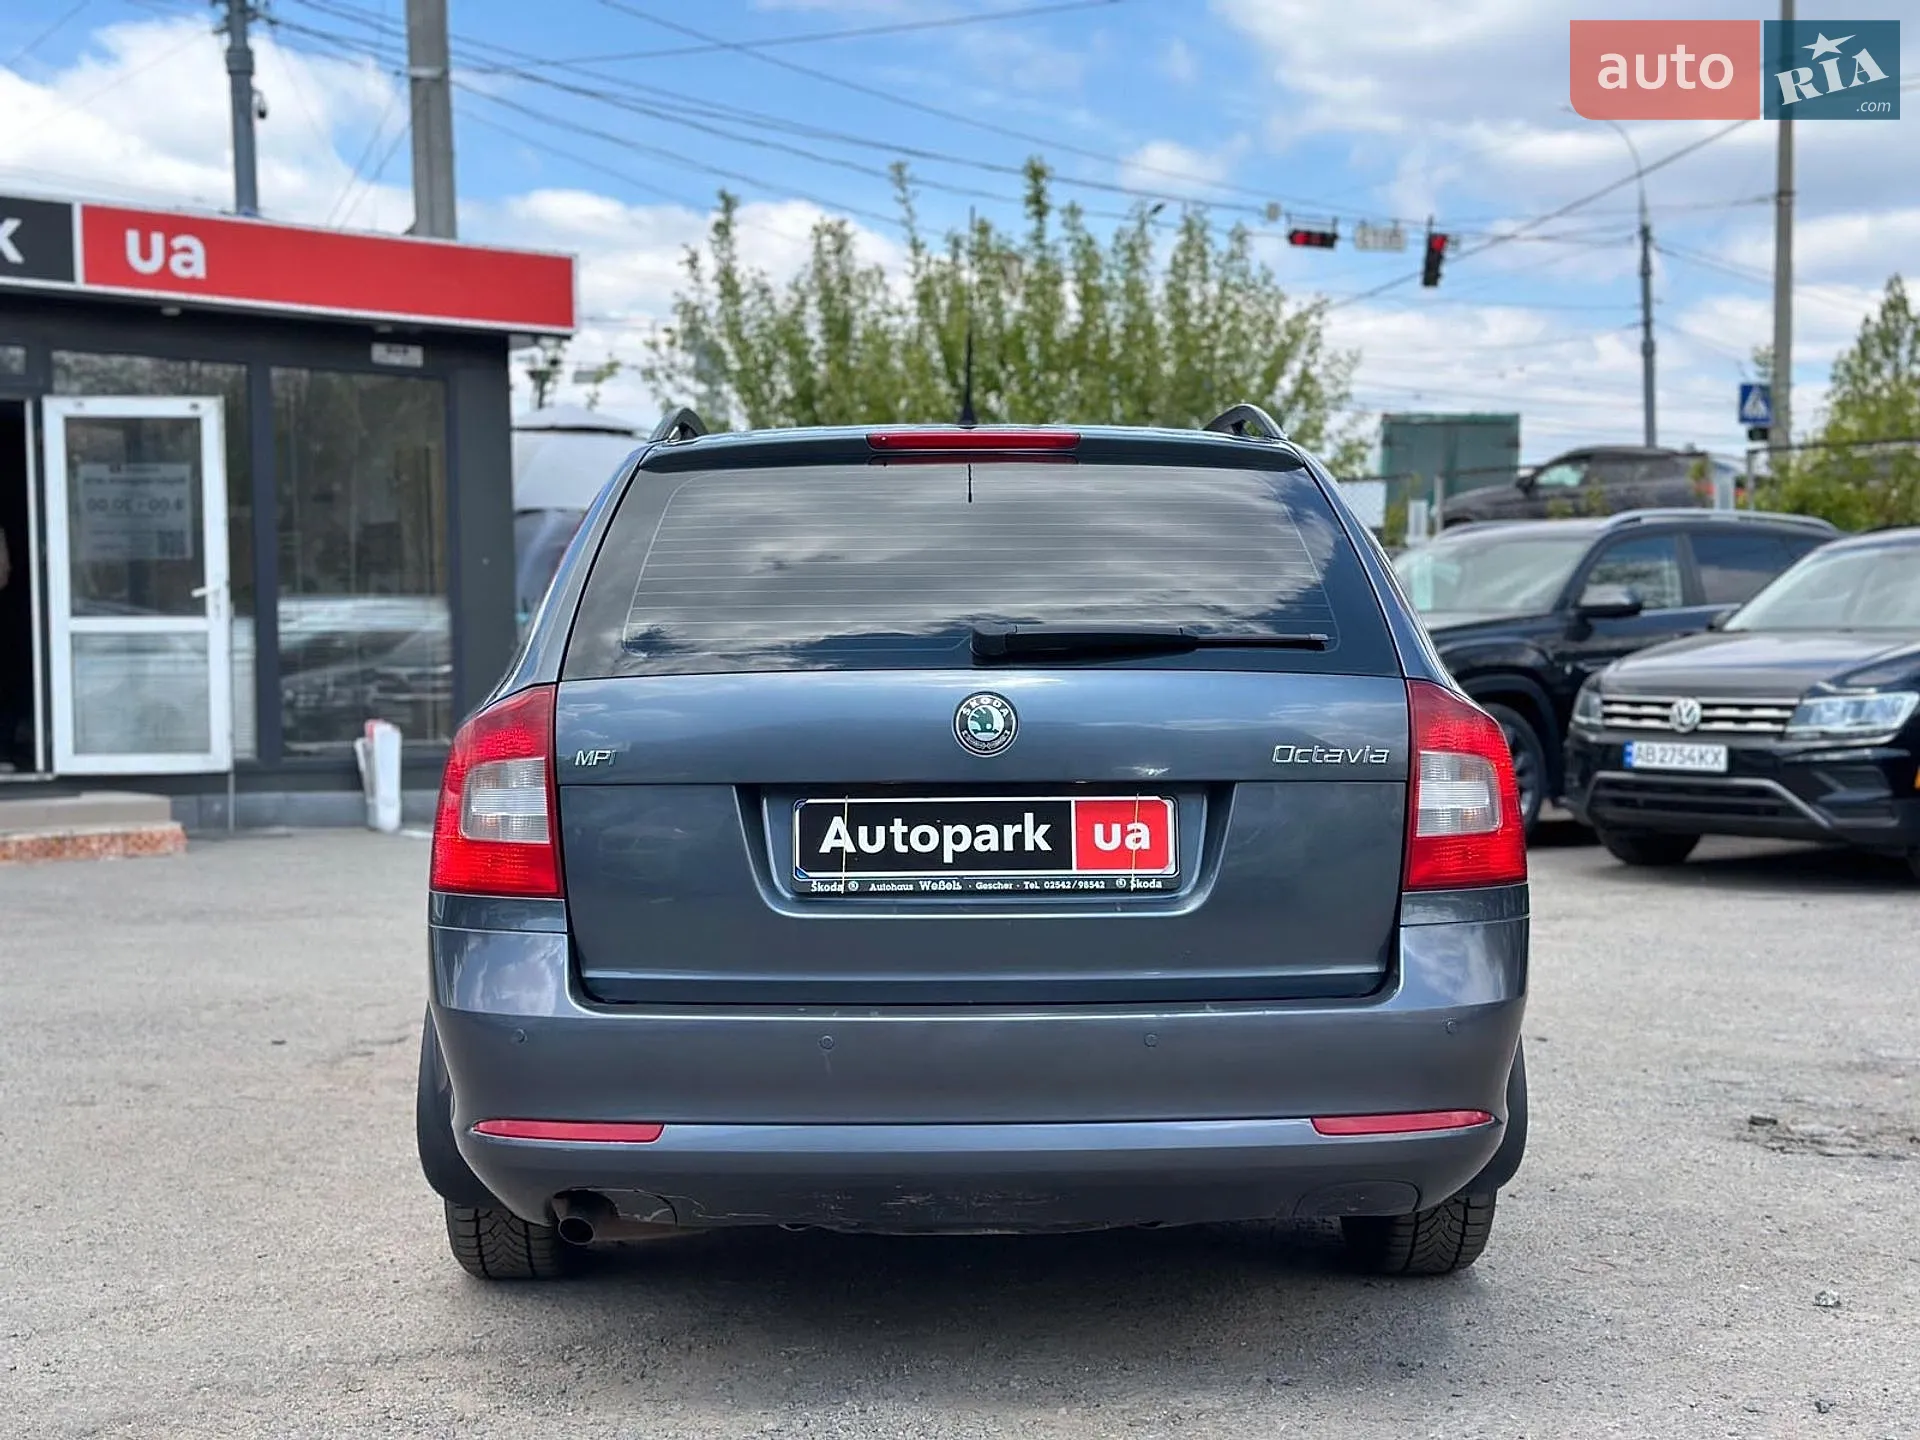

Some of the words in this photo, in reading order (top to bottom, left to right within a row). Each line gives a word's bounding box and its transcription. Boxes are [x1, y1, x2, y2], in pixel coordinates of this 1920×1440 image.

[125, 228, 207, 279] ua
[1272, 745, 1390, 763] Octavia
[819, 812, 1053, 863] Autopark
[1094, 822, 1151, 851] ua
[869, 883, 913, 891] Autohaus
